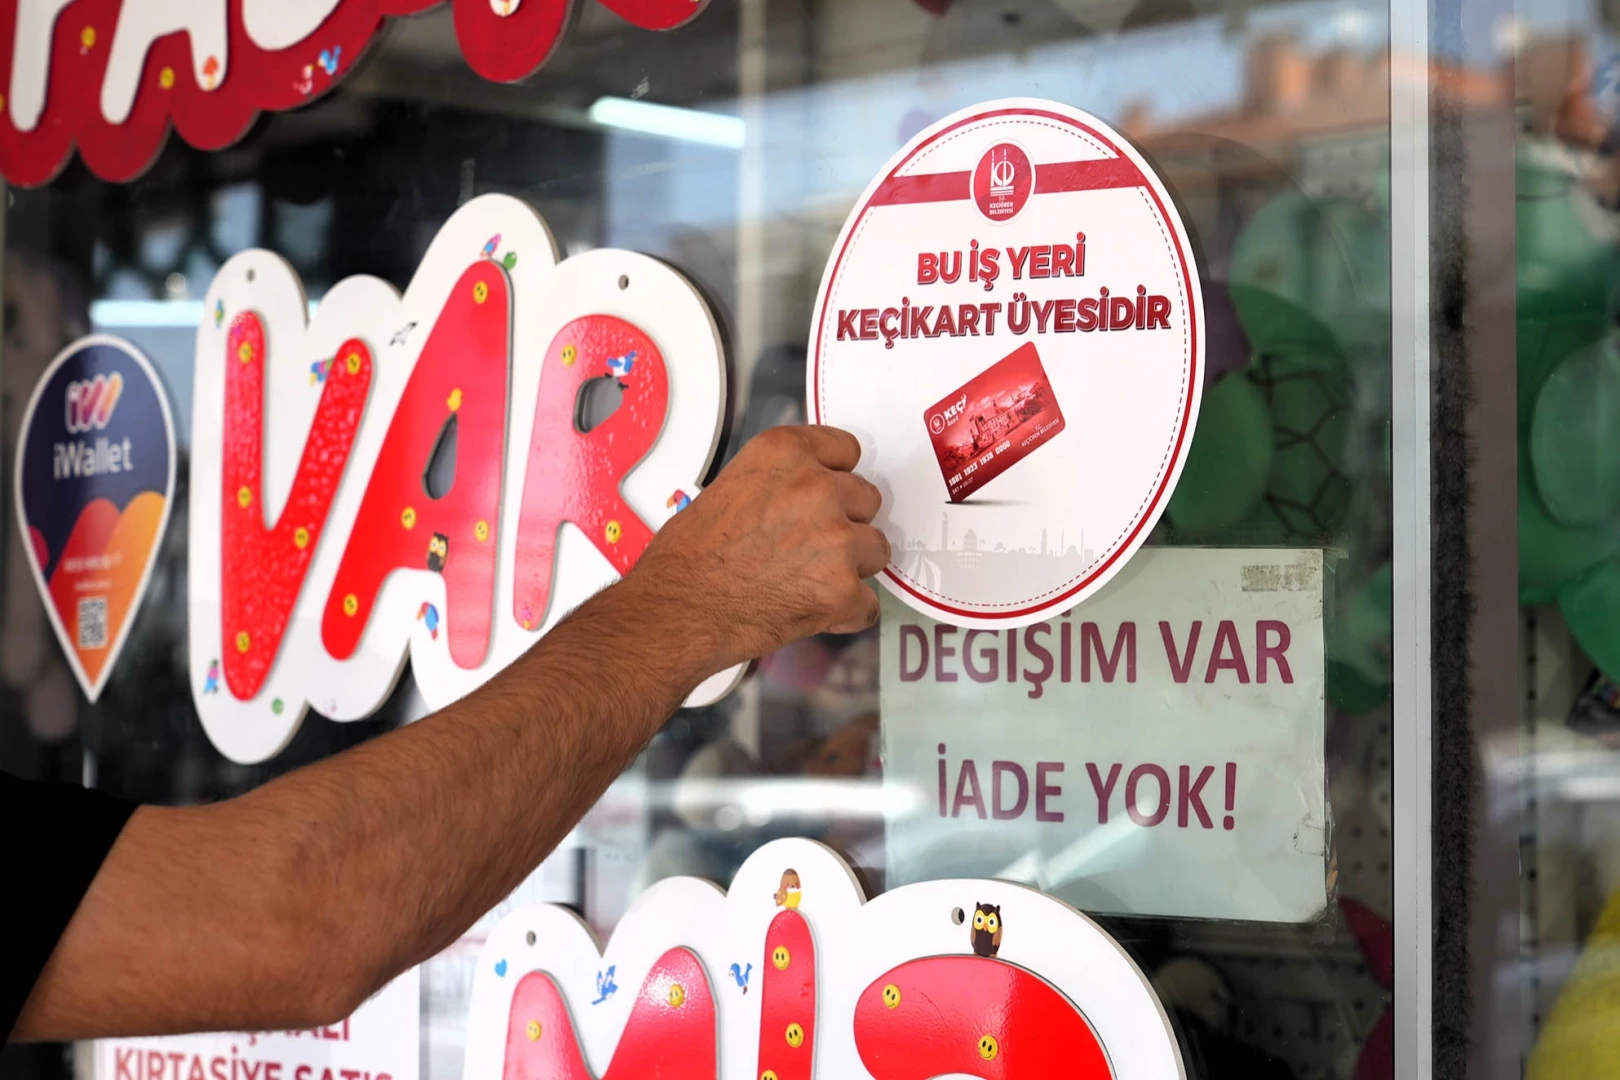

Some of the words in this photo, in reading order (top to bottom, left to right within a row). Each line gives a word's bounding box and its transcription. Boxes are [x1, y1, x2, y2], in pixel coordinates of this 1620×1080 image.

[917, 250, 963, 285] BU
[968, 239, 1001, 290] İŞ
[1007, 231, 1086, 279] YERİ
[836, 296, 1002, 348] KEÇİKART
[1006, 284, 1172, 335] ÜYESİDİR
[53, 436, 133, 480] iWallet
[221, 260, 669, 702] VAR
[1157, 620, 1294, 684] VAR
[937, 743, 1065, 823] İADE
[1085, 761, 1237, 831] YOK!
